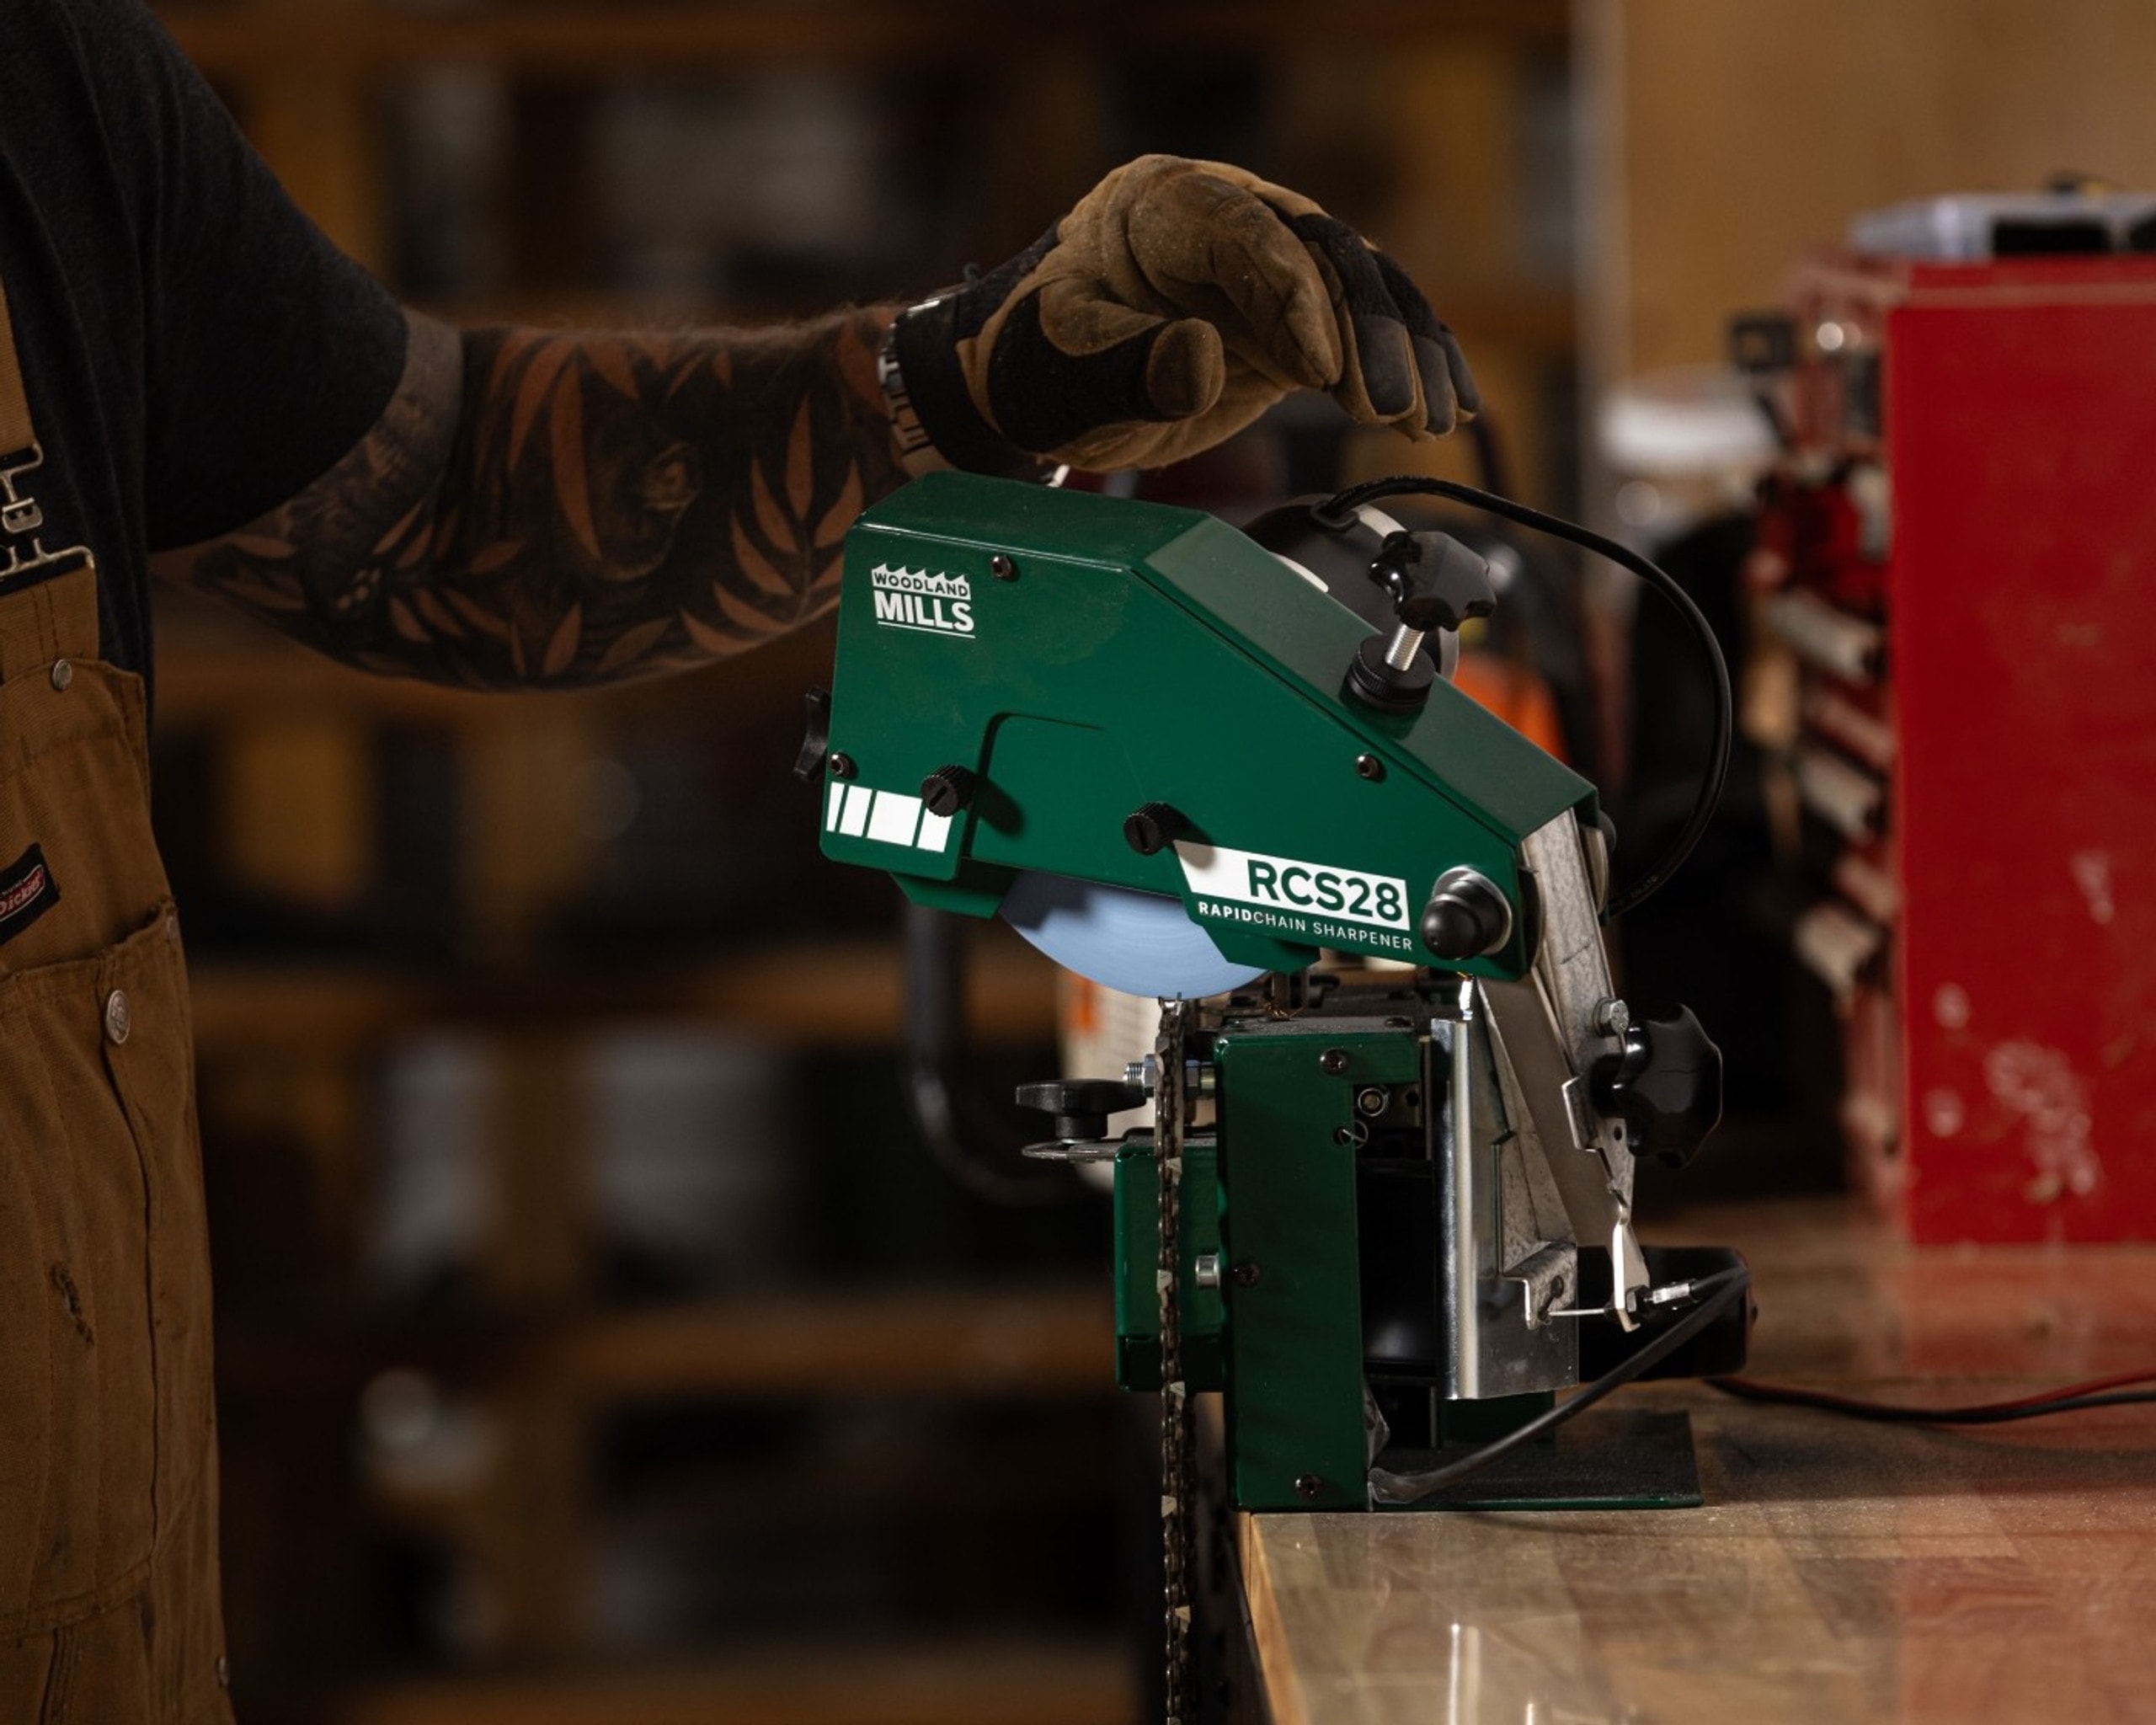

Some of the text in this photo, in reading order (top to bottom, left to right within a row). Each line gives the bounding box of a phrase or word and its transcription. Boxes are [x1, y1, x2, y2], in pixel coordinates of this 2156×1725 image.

[874, 572, 968, 596] WOODLAND
[873, 590, 974, 632] MILLS
[1247, 858, 1402, 921] RCS28
[1198, 901, 1412, 951] RAPIDCHAIN SHARPENER
